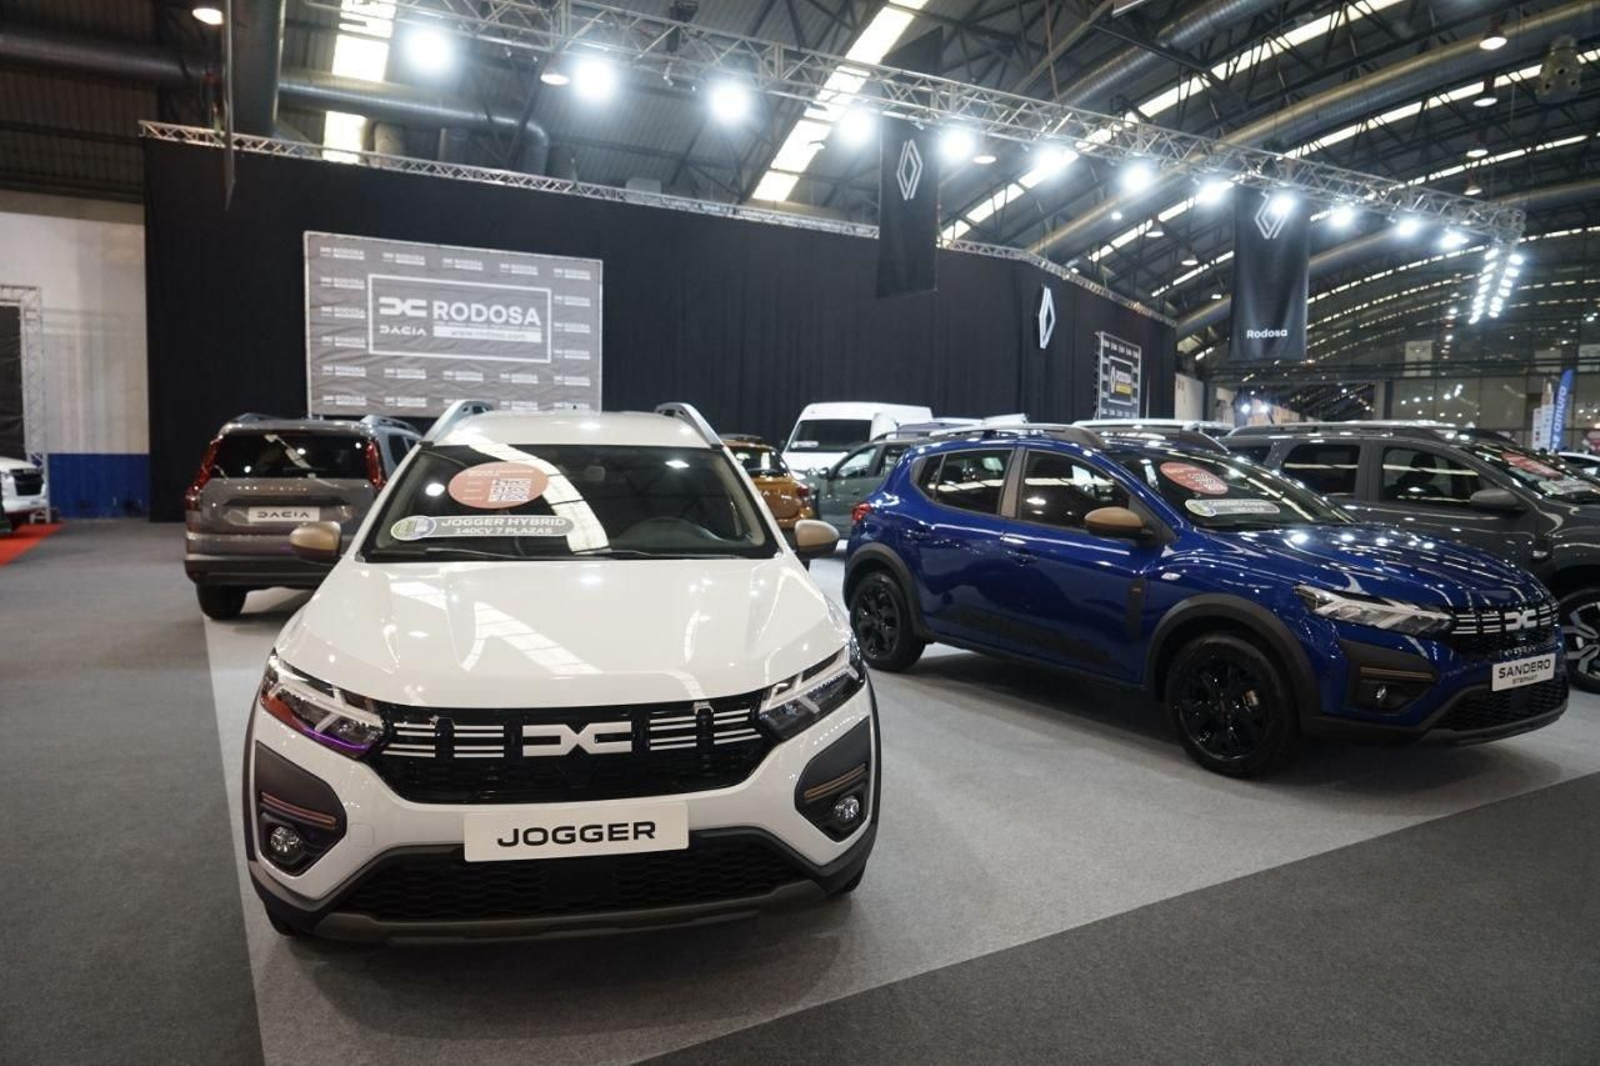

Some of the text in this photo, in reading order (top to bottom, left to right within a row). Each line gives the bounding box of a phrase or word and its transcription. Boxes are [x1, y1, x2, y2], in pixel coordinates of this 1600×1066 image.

[432, 300, 541, 326] RODOSA
[379, 325, 427, 337] DACIA
[1246, 328, 1288, 339] Rodosa
[257, 511, 310, 519] DACIA
[441, 517, 567, 527] JOGGER HYBRID
[1498, 659, 1551, 679] SANDERO
[497, 821, 656, 847] JOGGER
